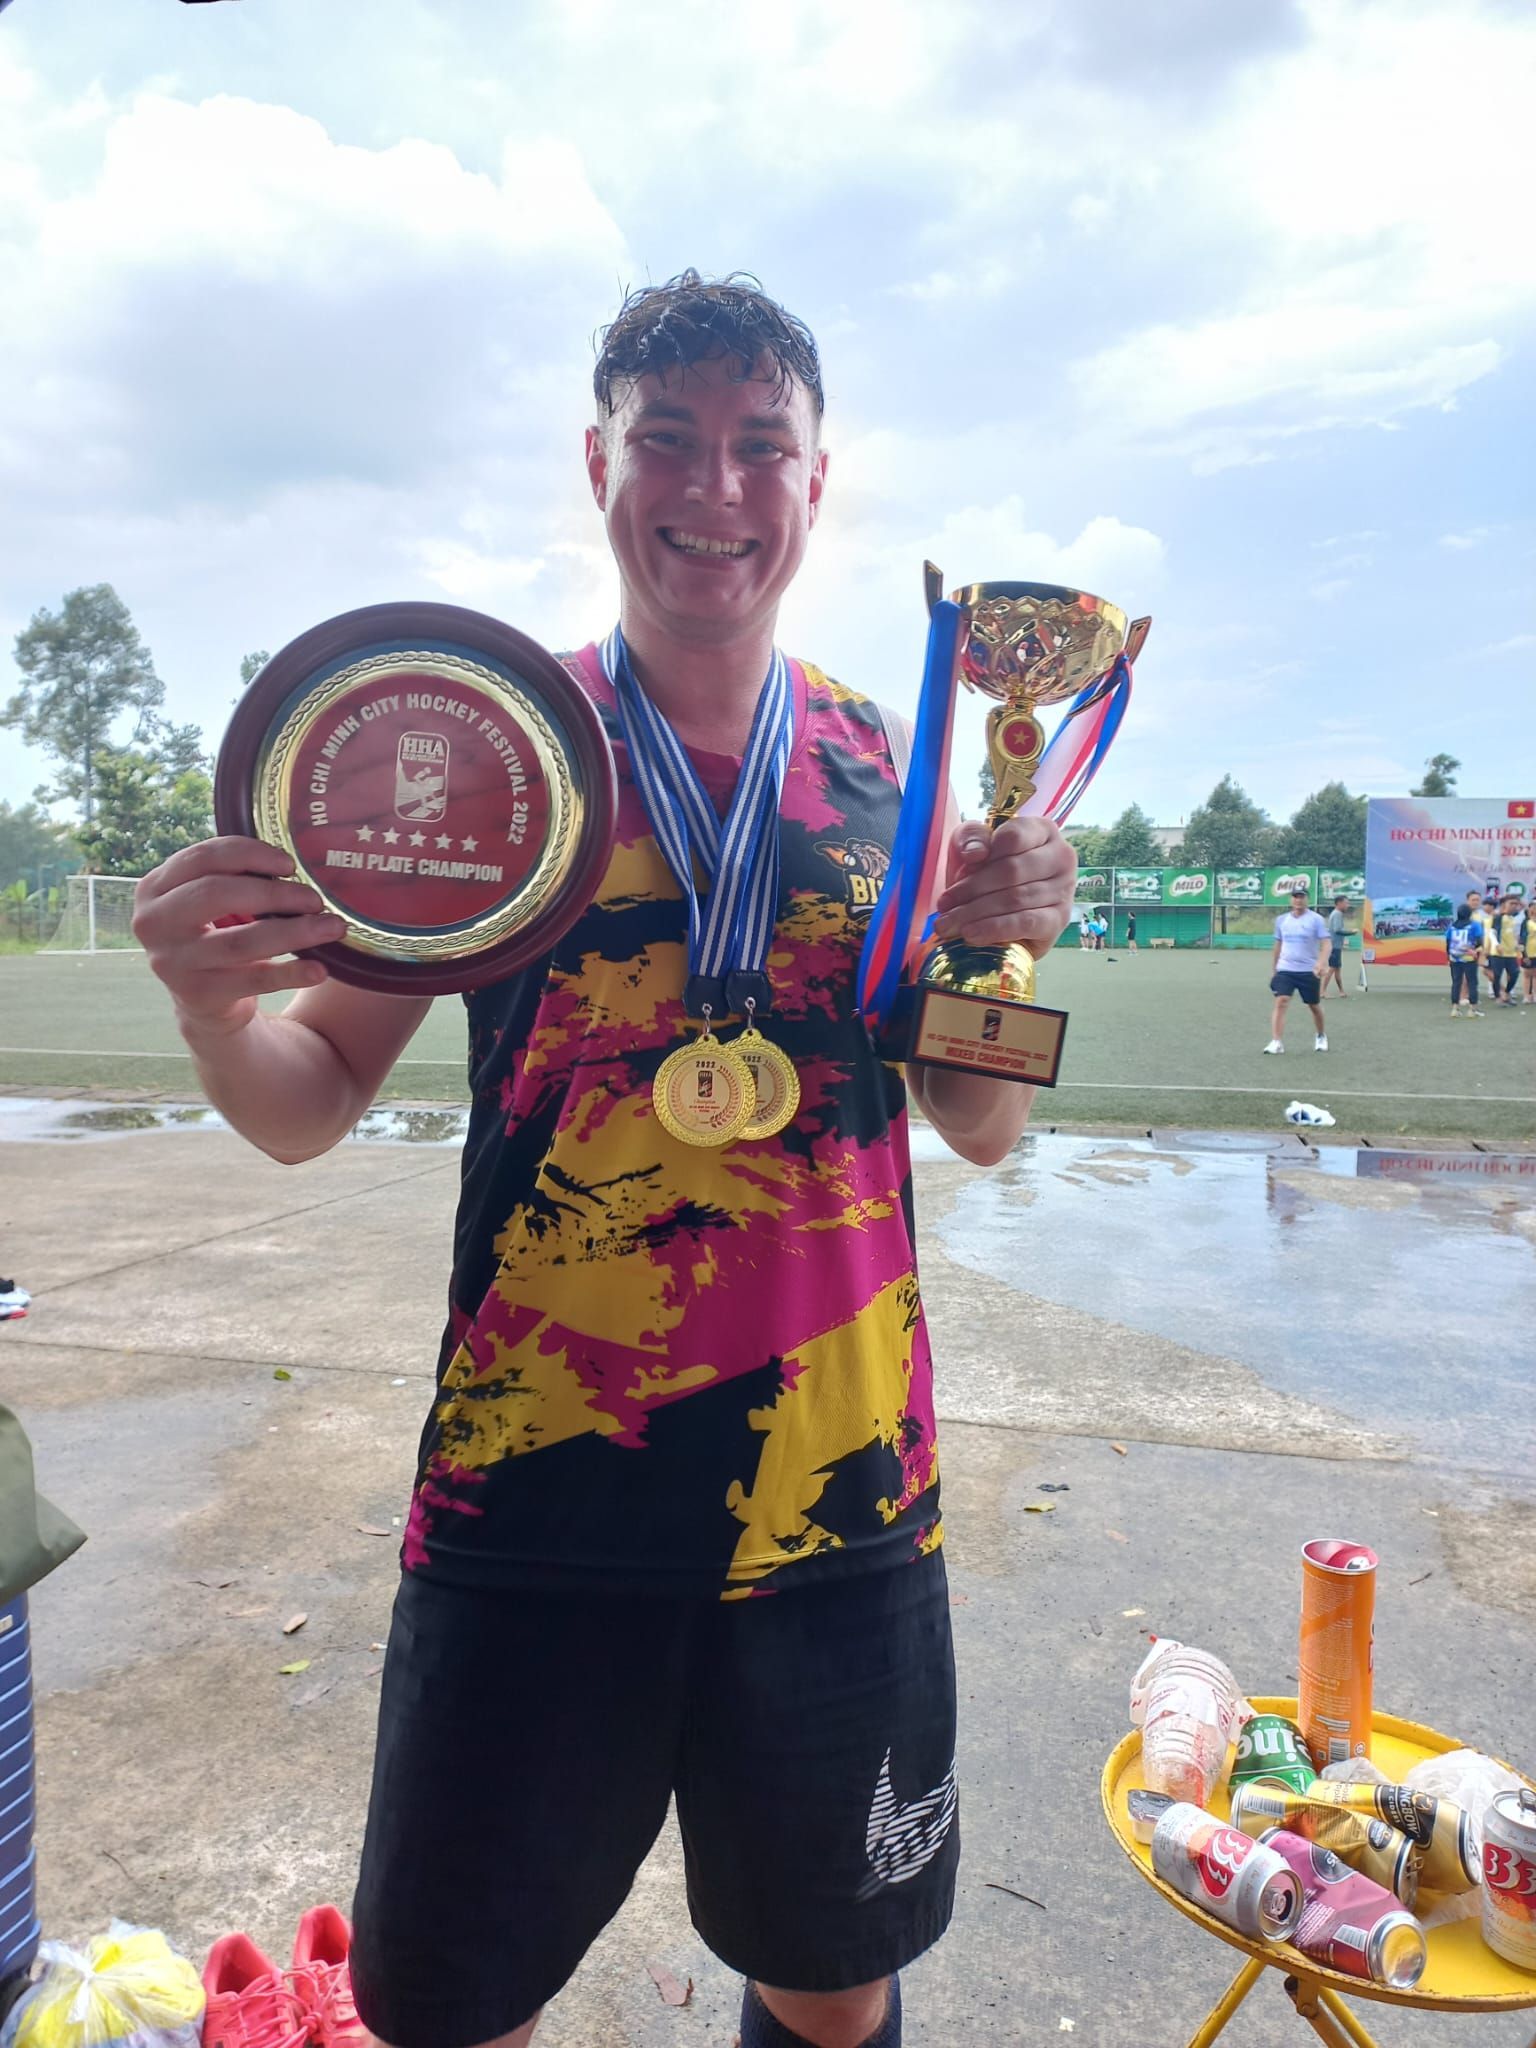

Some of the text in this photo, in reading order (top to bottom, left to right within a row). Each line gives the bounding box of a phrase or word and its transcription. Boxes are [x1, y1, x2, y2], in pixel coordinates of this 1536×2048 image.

[402, 737, 446, 757] HHA
[309, 693, 528, 845] HO CHI MINH CITY HOCKEY FESTIVAL 2022
[1390, 828, 1414, 841] HO
[1417, 828, 1446, 841] CHI
[1450, 828, 1492, 841] MINH
[1501, 846, 1532, 857] 2022
[326, 850, 503, 882] MEN PLATE CHAMPION
[1173, 879, 1204, 891] MILO
[946, 1047, 1026, 1069] MIXED CHAMPION
